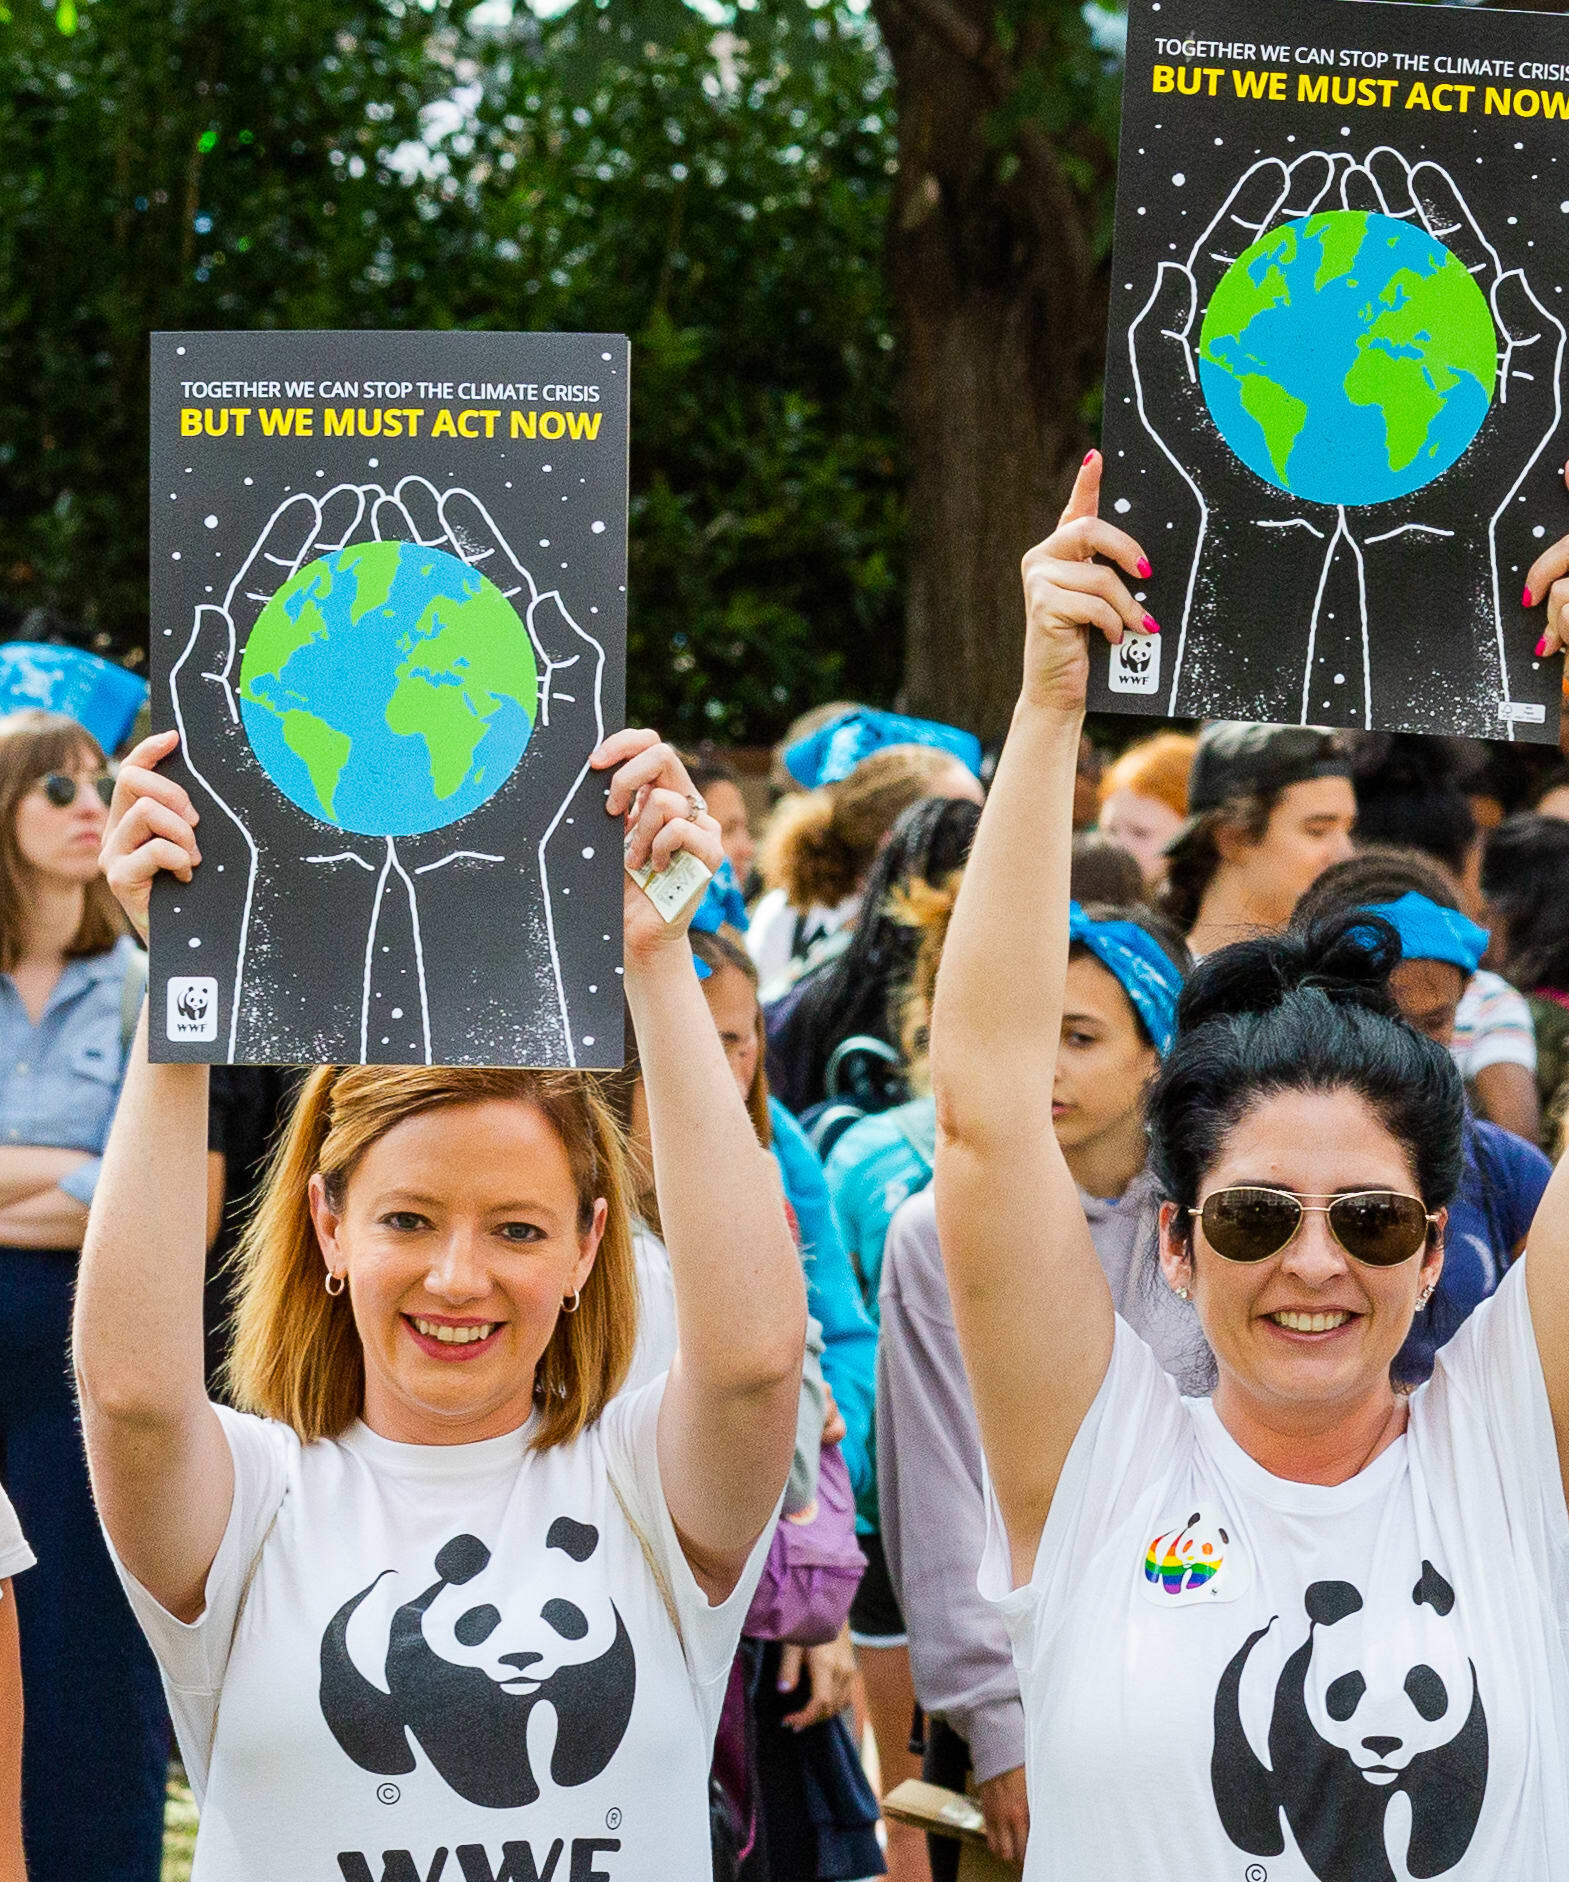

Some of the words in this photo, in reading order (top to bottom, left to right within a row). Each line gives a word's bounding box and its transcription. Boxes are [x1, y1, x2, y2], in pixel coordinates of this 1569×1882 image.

[1155, 38, 1256, 62] TOGETHER
[1260, 45, 1290, 62] WE
[1295, 47, 1334, 65] CAN
[1339, 50, 1388, 68] STOP
[1393, 54, 1430, 71] THE
[1434, 57, 1514, 77] CLIMATE
[1153, 65, 1225, 96] BUT
[1232, 70, 1287, 100] WE
[1298, 74, 1398, 107] MUST
[1405, 82, 1475, 112] ACT
[181, 381, 281, 398] TOGETHER
[285, 381, 314, 398] WE
[319, 381, 358, 398] CAN
[363, 382, 413, 398] STOP
[416, 382, 453, 399] THE
[458, 383, 538, 401] CLIMATE
[542, 384, 600, 402] CRISIS
[181, 408, 251, 436] BUT
[258, 408, 313, 436] WE
[324, 408, 424, 437] MUST
[432, 409, 501, 438] ACT
[510, 411, 602, 440] NOW
[1119, 675, 1150, 686] WWF
[176, 1023, 208, 1034] WWF
